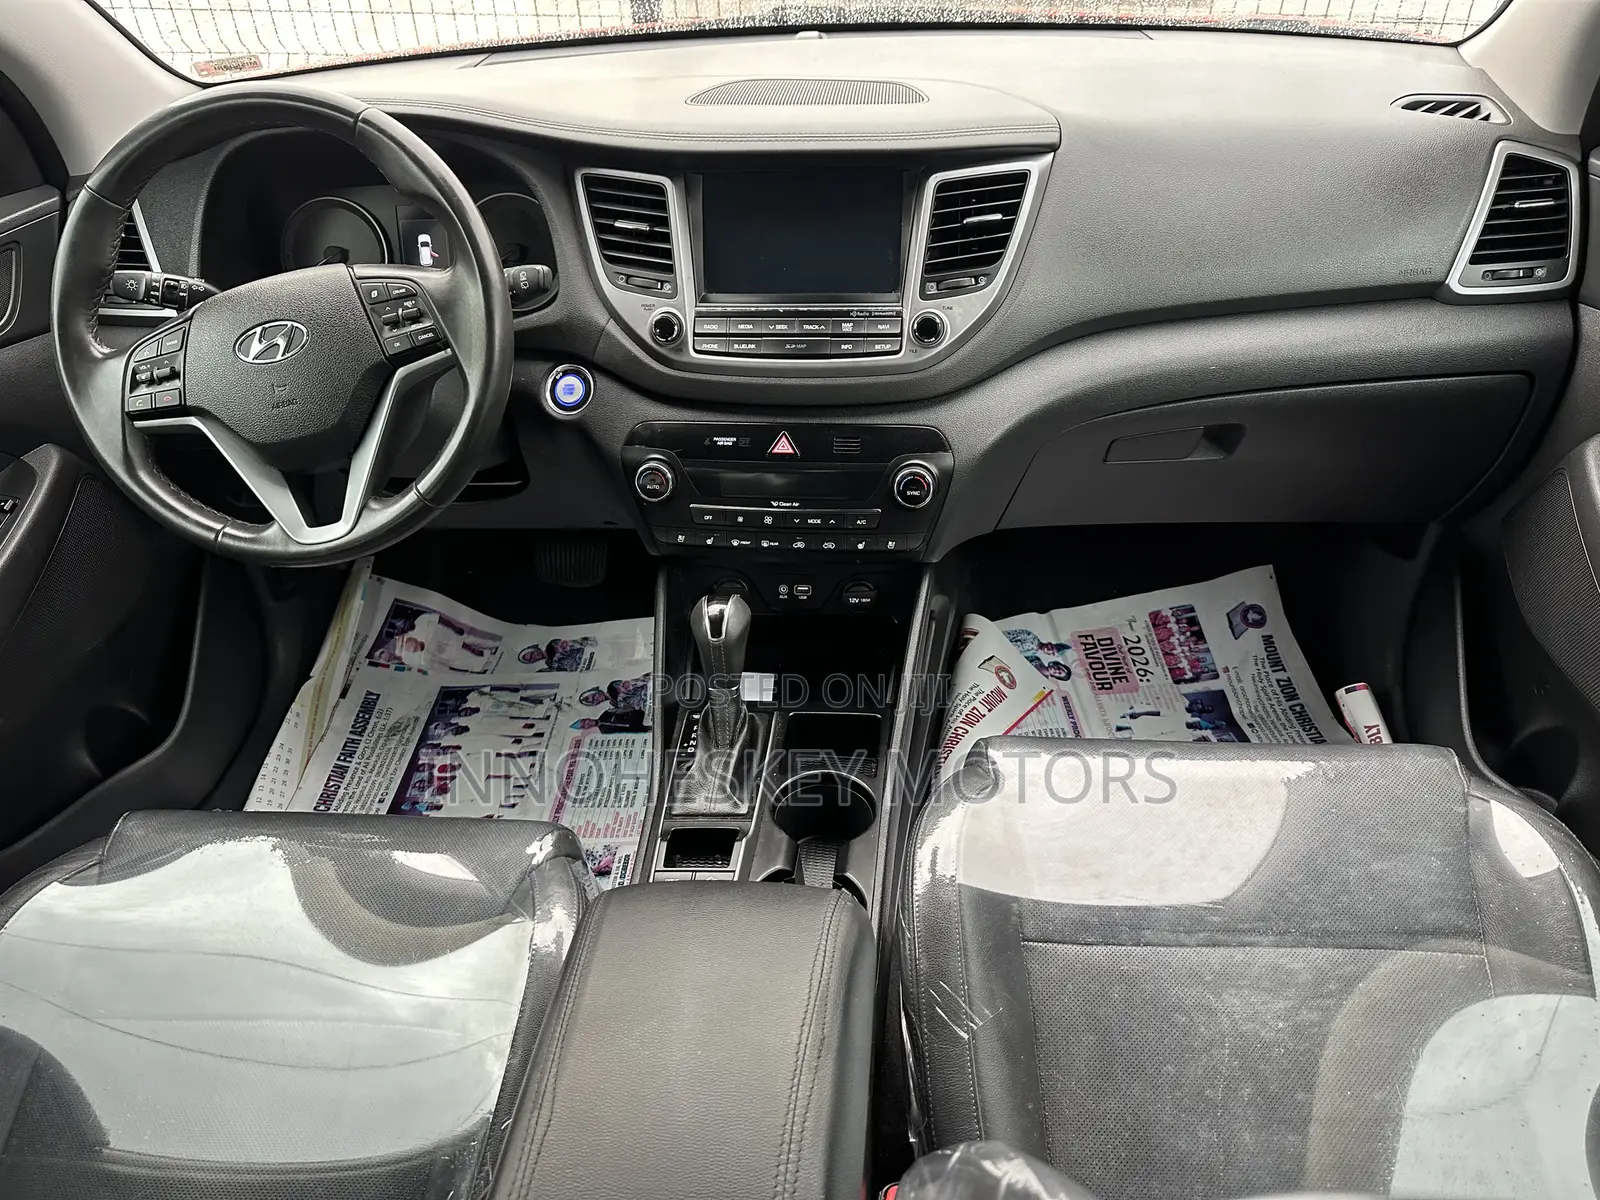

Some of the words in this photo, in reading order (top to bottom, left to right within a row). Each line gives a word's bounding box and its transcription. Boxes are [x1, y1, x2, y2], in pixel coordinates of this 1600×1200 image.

[1078, 634, 1113, 690] FAVOUR
[1097, 637, 1129, 684] DIVINE
[1122, 635, 1154, 682] 2026:
[1261, 635, 1287, 673] MOUNT
[1275, 676, 1300, 702] ZION
[1263, 670, 1275, 687] Place
[979, 686, 1008, 713] MOUNT
[1062, 696, 1075, 720] WEEKLY
[960, 706, 986, 728] ZION
[313, 762, 344, 812] CHRISTIAN
[338, 734, 362, 763] FAITH
[352, 689, 381, 736] ASSEMBLY
[343, 765, 359, 792] Presence
[353, 774, 363, 790] Land
